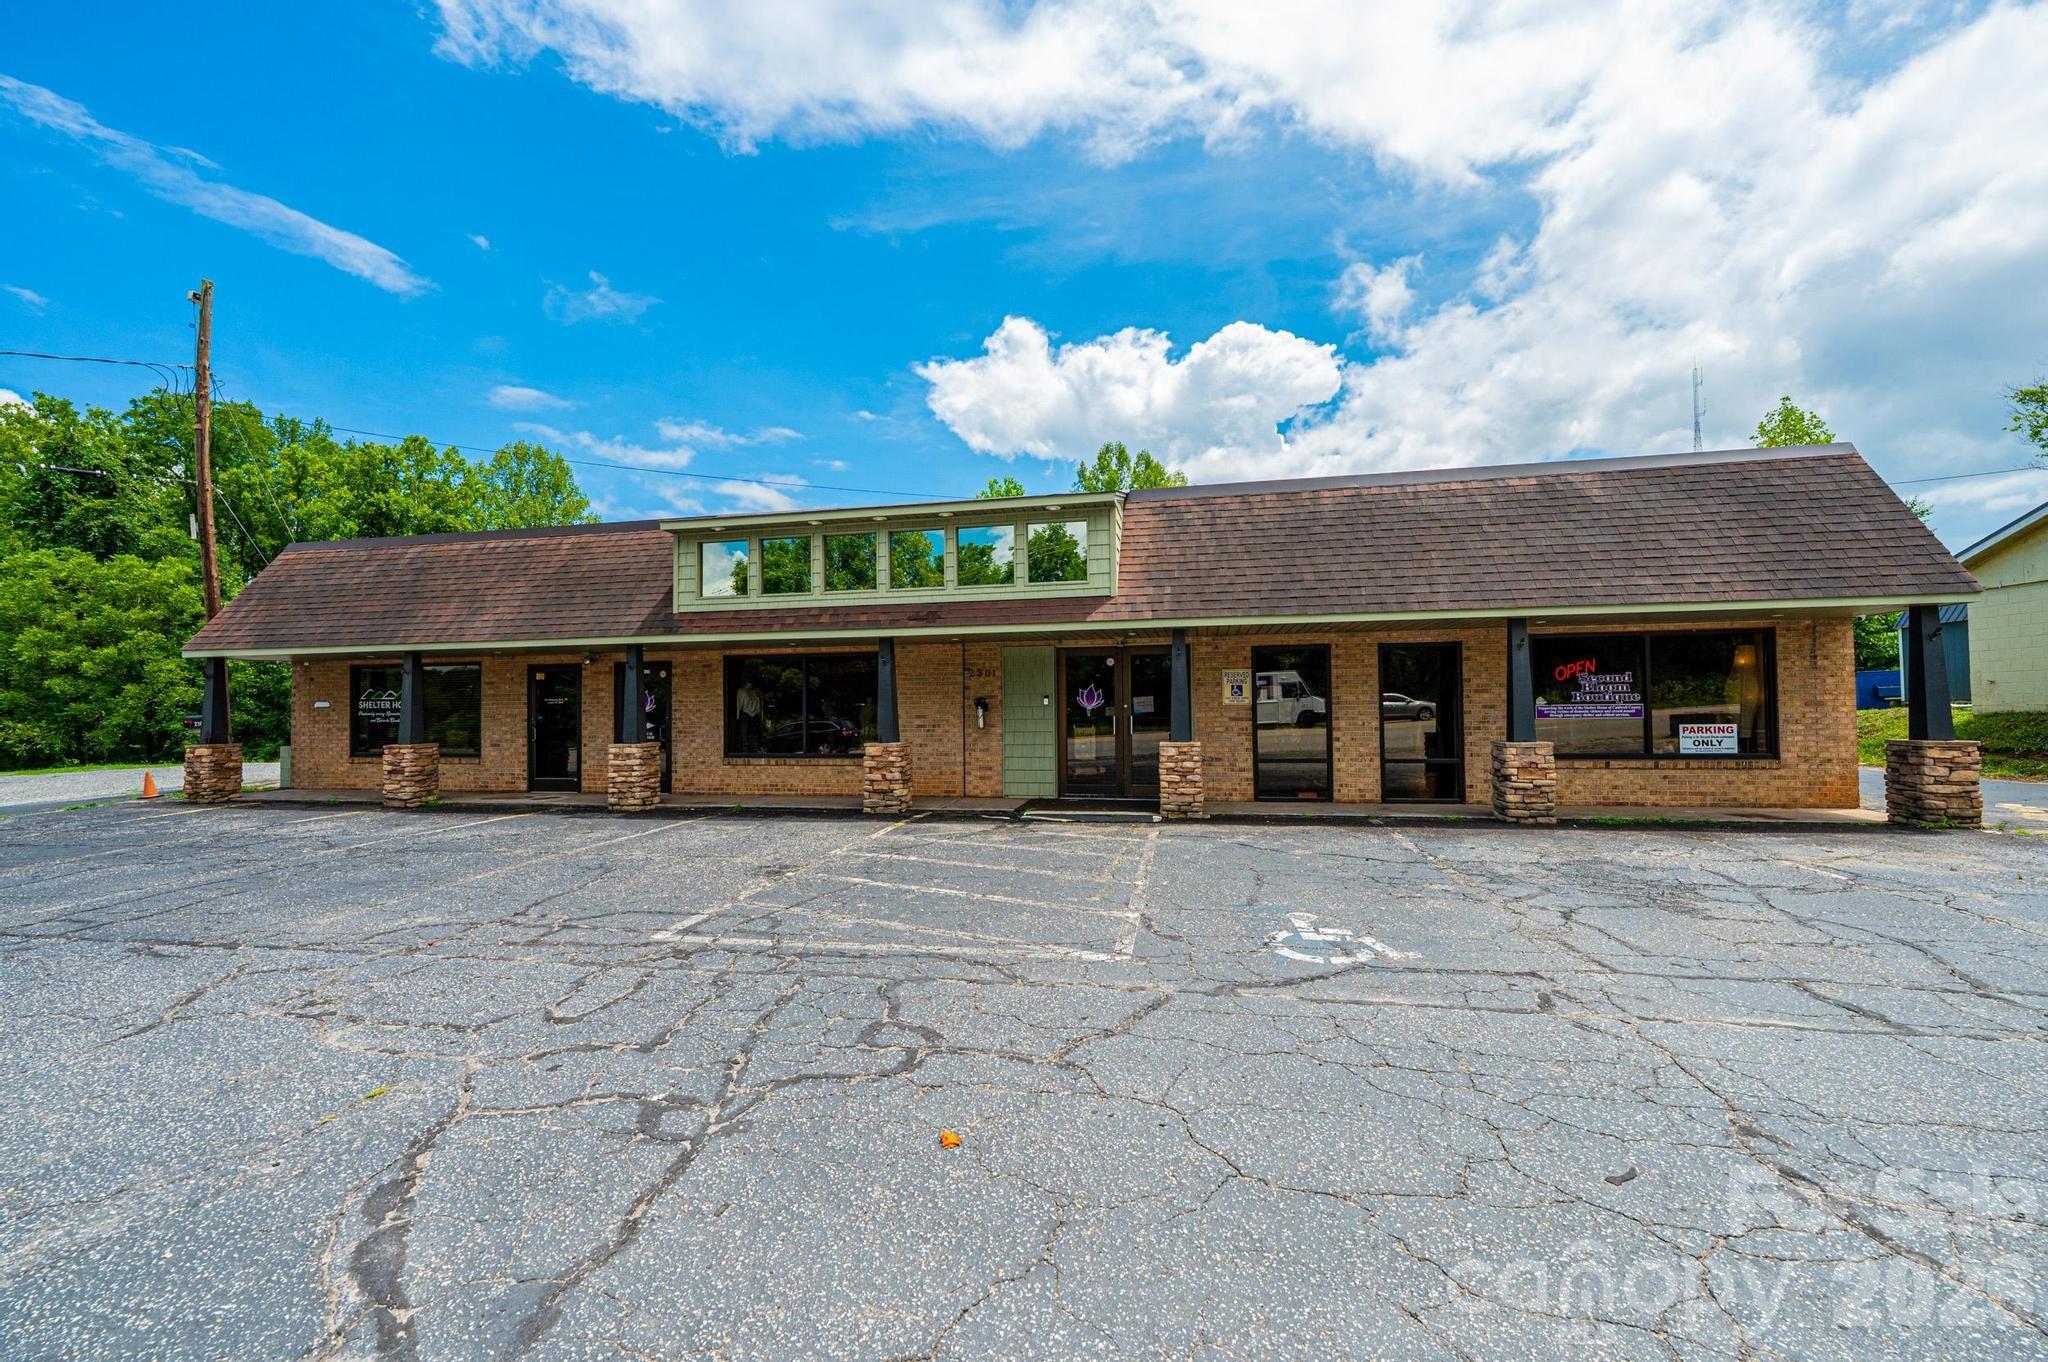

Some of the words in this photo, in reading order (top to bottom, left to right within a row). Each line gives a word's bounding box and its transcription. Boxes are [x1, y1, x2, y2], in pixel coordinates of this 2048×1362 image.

[1553, 658, 1597, 681] OPEN
[1579, 671, 1633, 682] Second
[1581, 681, 1631, 692] Bloom
[1571, 691, 1641, 704] Boutique
[359, 700, 391, 709] SHELTER
[1682, 726, 1735, 735] PARKING
[1692, 739, 1724, 747] ONLY
